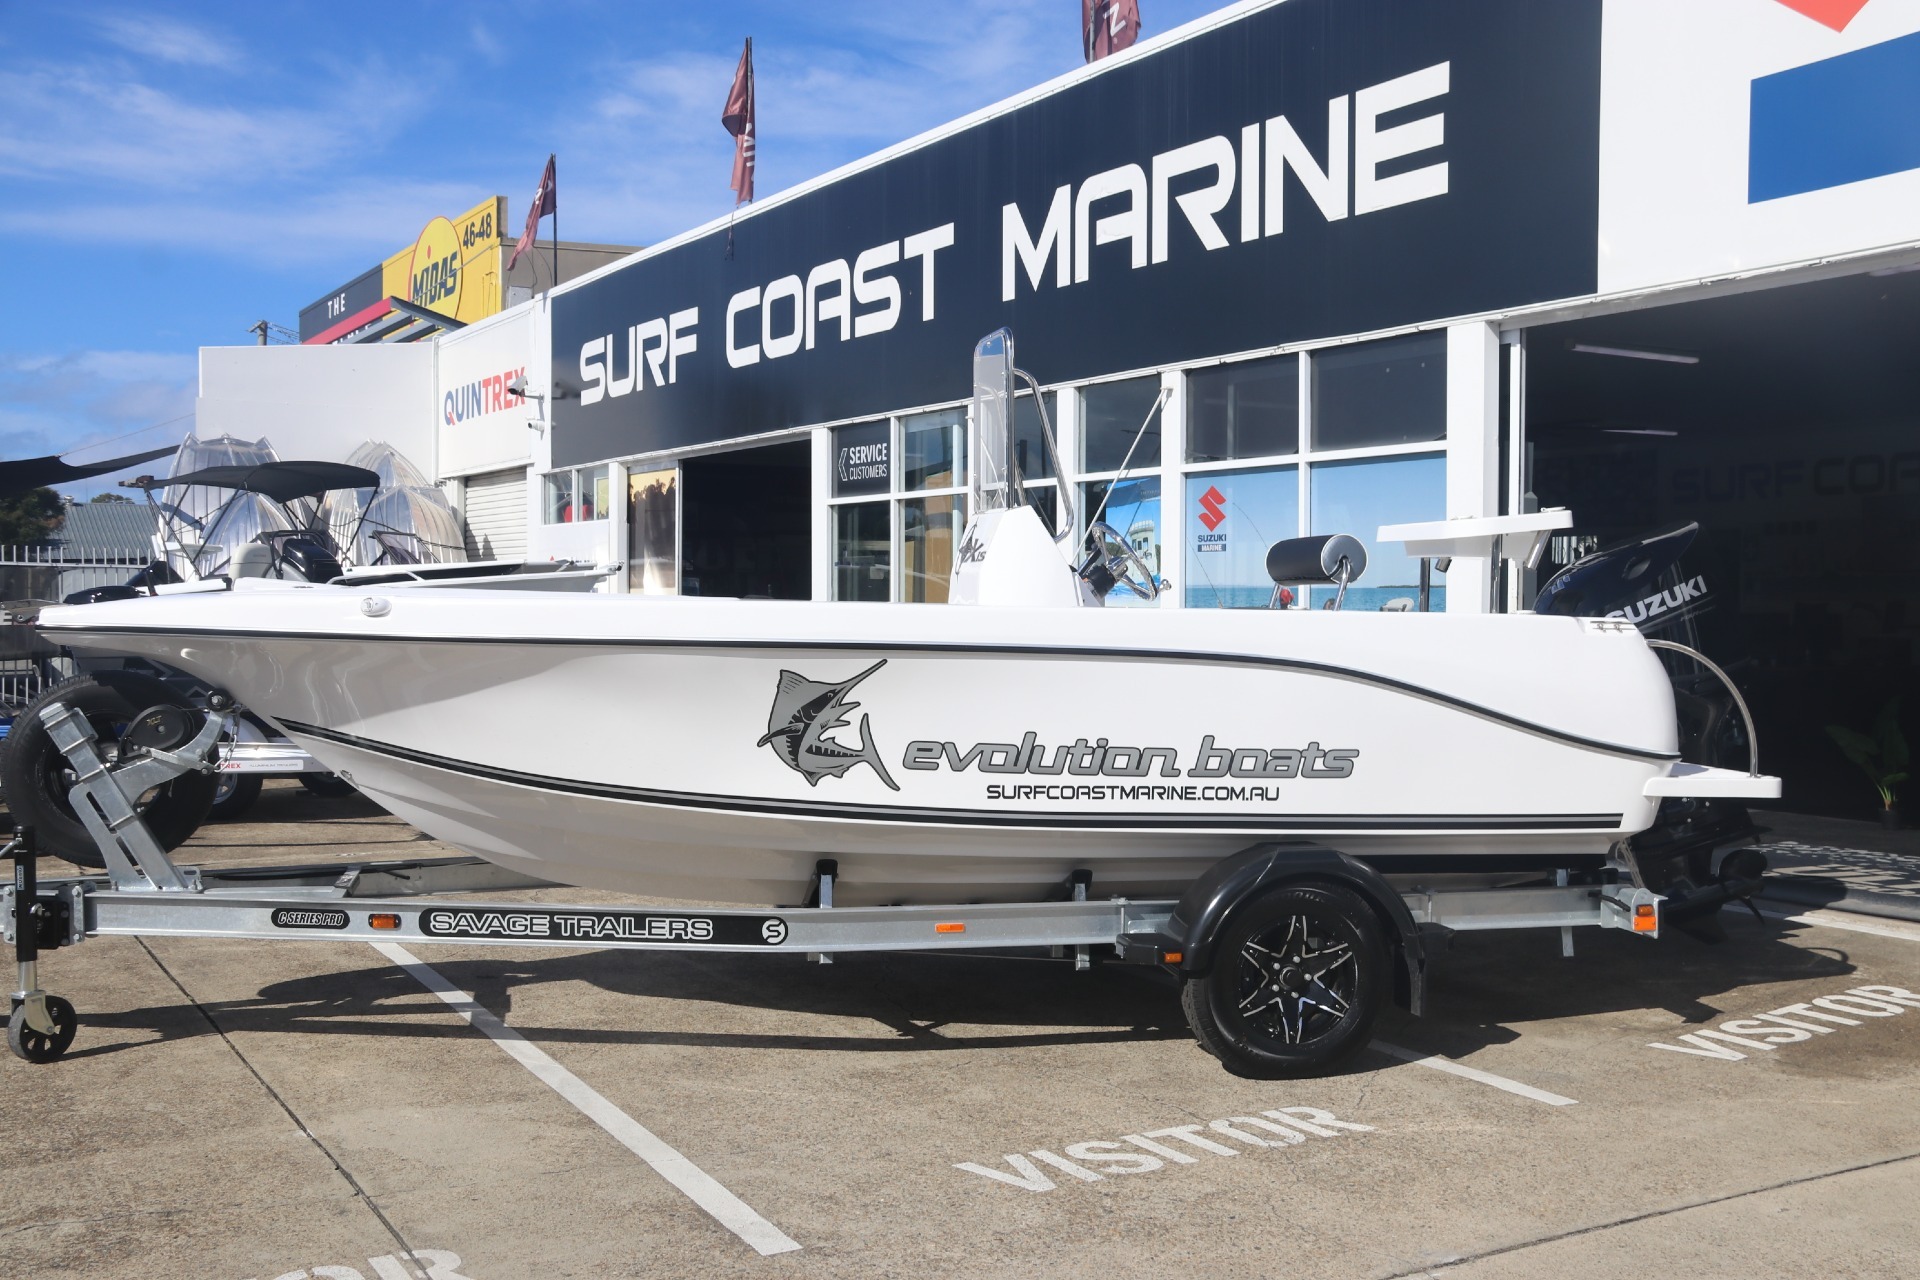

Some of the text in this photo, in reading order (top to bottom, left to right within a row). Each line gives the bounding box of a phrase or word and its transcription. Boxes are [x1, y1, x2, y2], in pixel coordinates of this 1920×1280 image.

[462, 212, 493, 250] 46-48
[580, 60, 1450, 407] SURF COAST MARINE
[412, 246, 458, 309] MIDAS
[327, 292, 346, 319] THE
[444, 366, 526, 426] QUINTREX
[849, 442, 888, 465] SERVICE
[849, 463, 888, 481] CUSTOMERS
[1197, 533, 1227, 543] SUZUKI
[1201, 544, 1223, 552] MARINE
[902, 731, 1360, 779] evolution boats
[986, 784, 1280, 802] SURFCOASTMARINE.COM.AU
[277, 912, 345, 926] C SERIES PRO
[430, 912, 550, 936] SAVAGE
[554, 914, 714, 941] TRAILERS
[1646, 984, 1920, 1062] VISITOR
[951, 1105, 1378, 1193] VISITOR
